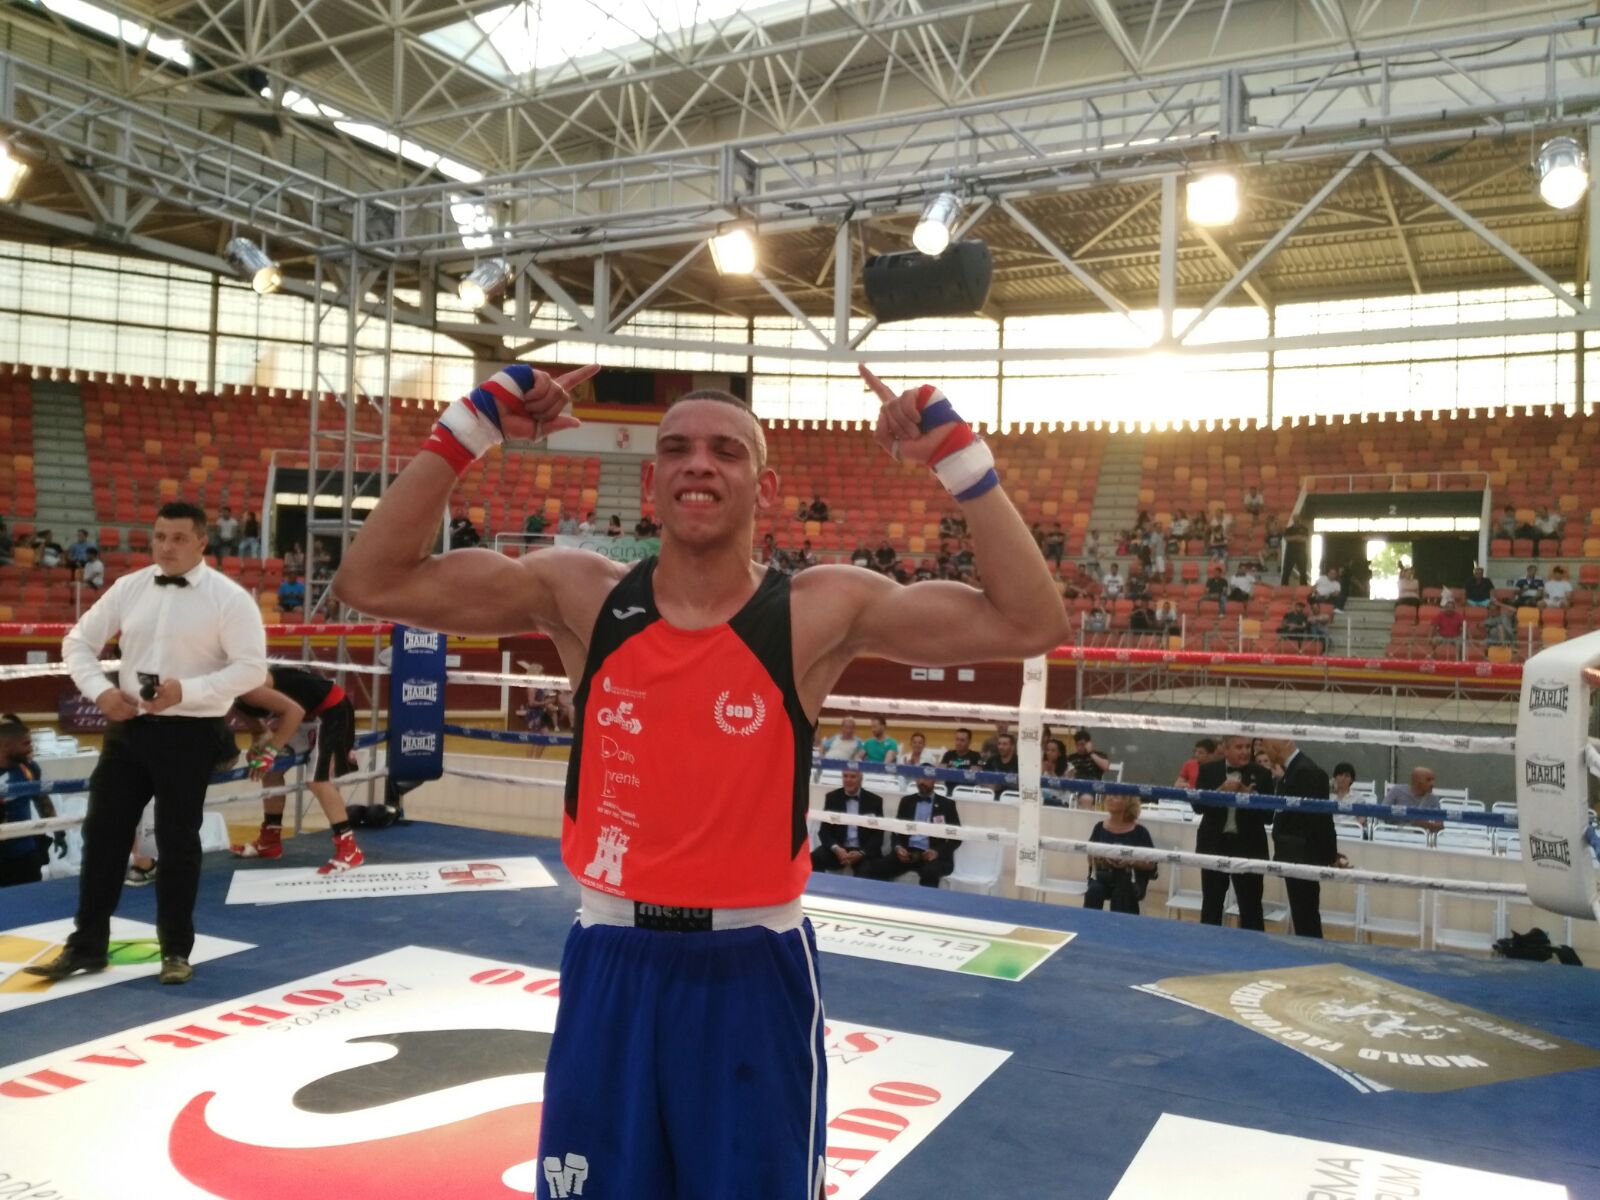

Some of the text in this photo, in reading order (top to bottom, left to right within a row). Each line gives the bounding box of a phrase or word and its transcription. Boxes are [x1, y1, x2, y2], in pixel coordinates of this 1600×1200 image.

[1388, 504, 1397, 515] 2
[404, 630, 438, 651] CHARLIE
[402, 682, 437, 703] CHARLIE
[1529, 684, 1568, 712] CHARLIE
[401, 733, 436, 754] CHARLIE
[1525, 759, 1565, 790] CHARLIE
[1529, 834, 1571, 867] CHARLIE
[933, 938, 981, 952] EL
[1358, 1047, 1490, 1068] WORLD
